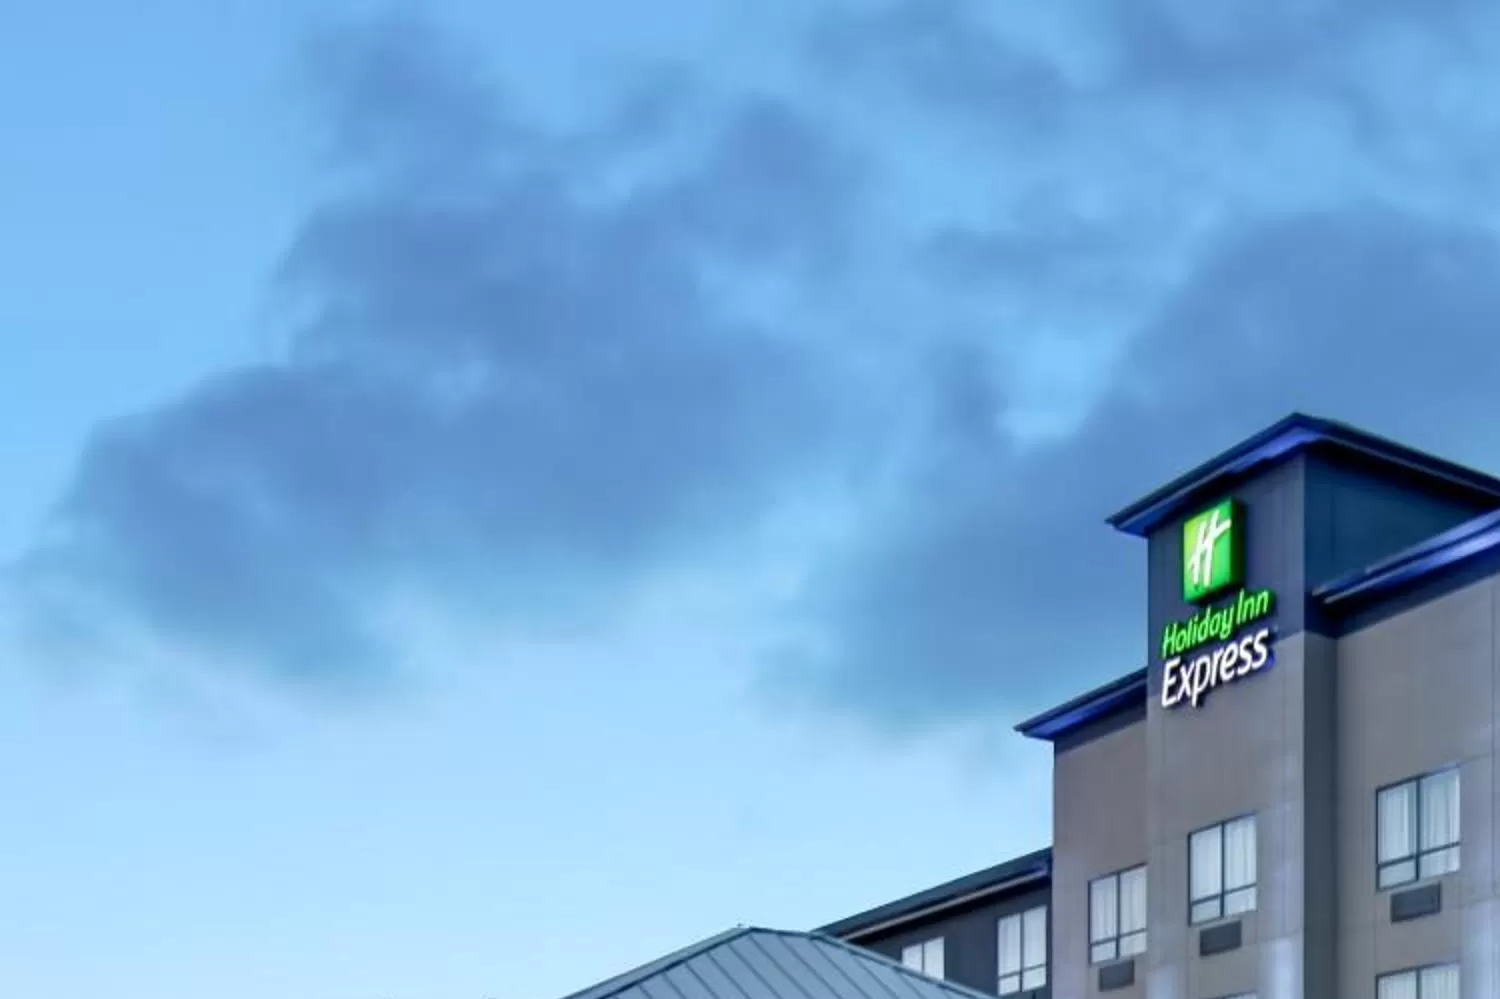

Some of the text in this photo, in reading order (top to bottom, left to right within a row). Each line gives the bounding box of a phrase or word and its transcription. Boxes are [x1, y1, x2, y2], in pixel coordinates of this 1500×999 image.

[1162, 588, 1270, 657] Holiday Inn
[1162, 628, 1269, 708] Express
